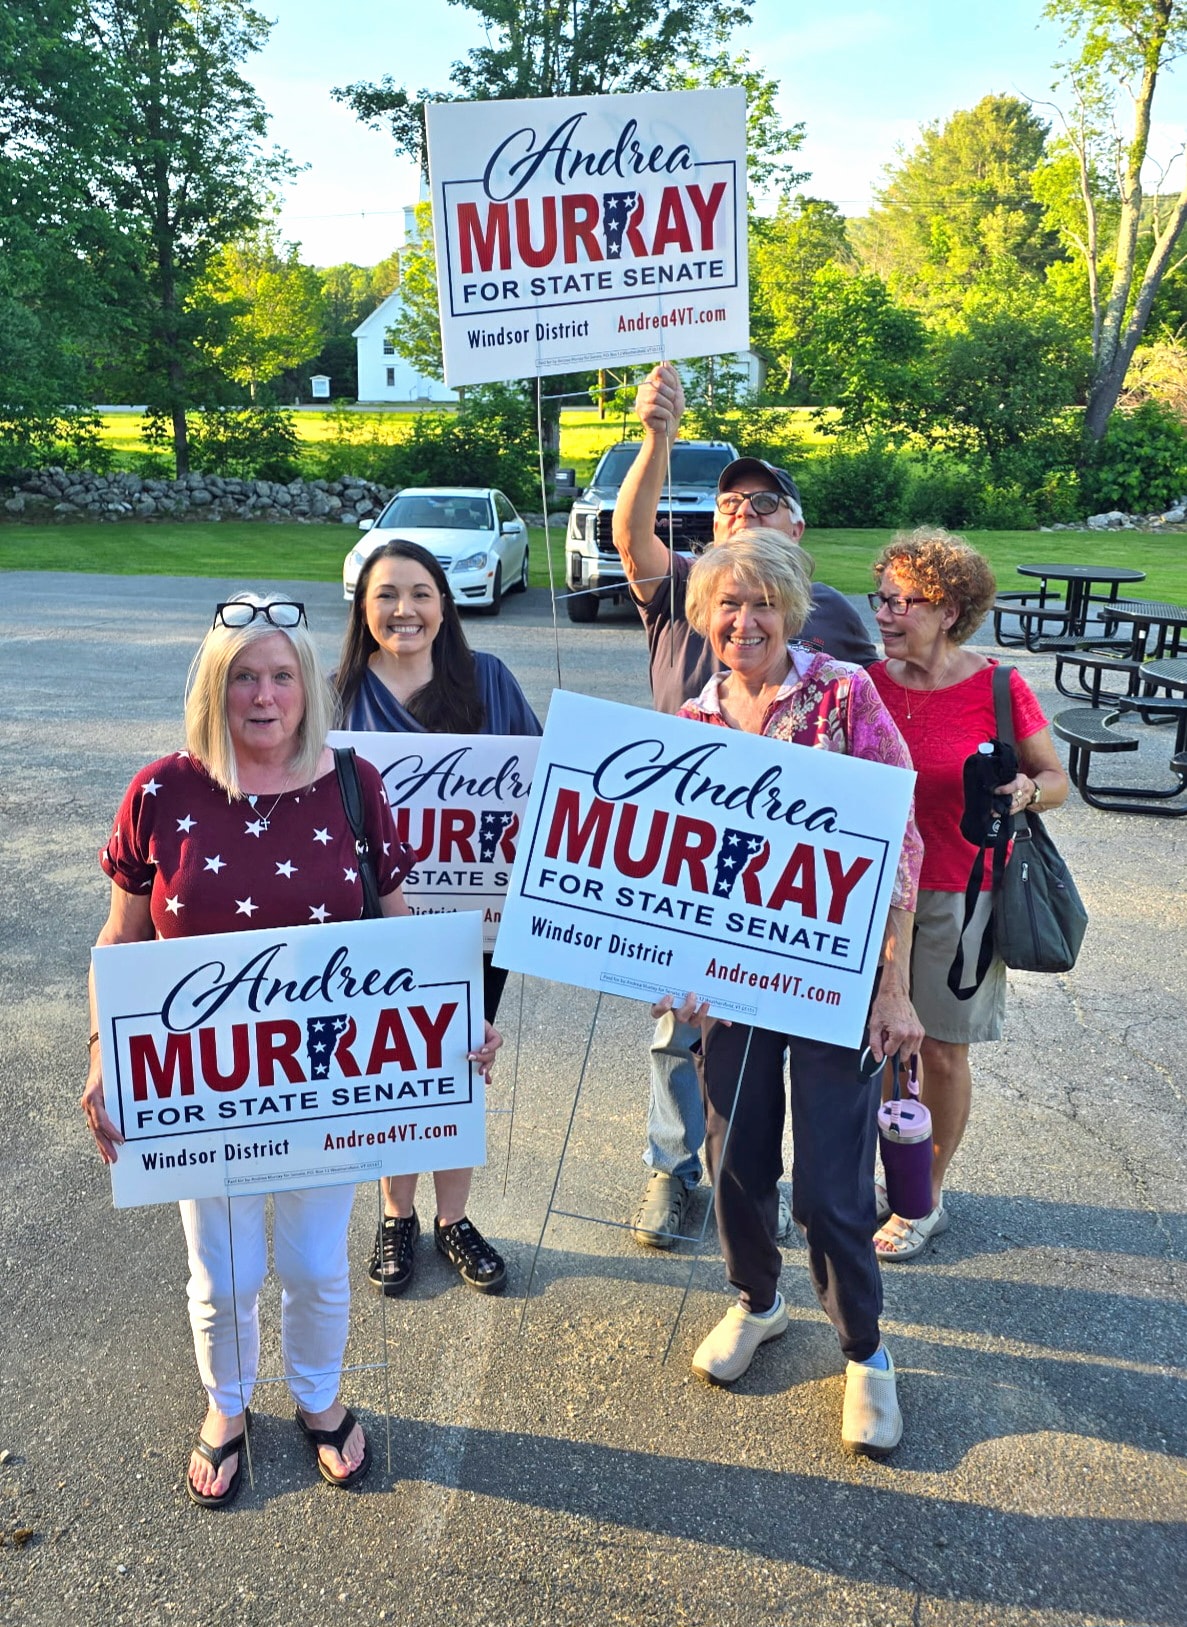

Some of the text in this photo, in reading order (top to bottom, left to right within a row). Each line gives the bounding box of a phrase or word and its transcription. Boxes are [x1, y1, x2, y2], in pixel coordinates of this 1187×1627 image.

[483, 112, 692, 202] Andrea
[457, 182, 727, 274] MURRAY
[464, 260, 724, 303] FOR STATE SENATE
[468, 307, 726, 349] Windsor District Andrea4VT.com
[381, 747, 532, 807] Andr
[593, 739, 839, 834] Andrea
[397, 808, 519, 863] URR
[406, 871, 483, 886] STATE
[544, 788, 874, 925] MURRAY
[539, 869, 851, 958] FOR STATE SENATE
[161, 943, 416, 1032] Andrea
[532, 916, 841, 1007] Windsor District Andrea4VT.com
[129, 1002, 459, 1101] MURRAY
[137, 1077, 455, 1128] FOR STATE SENATE
[142, 1124, 457, 1171] Windsor District Andrea4VT.com
